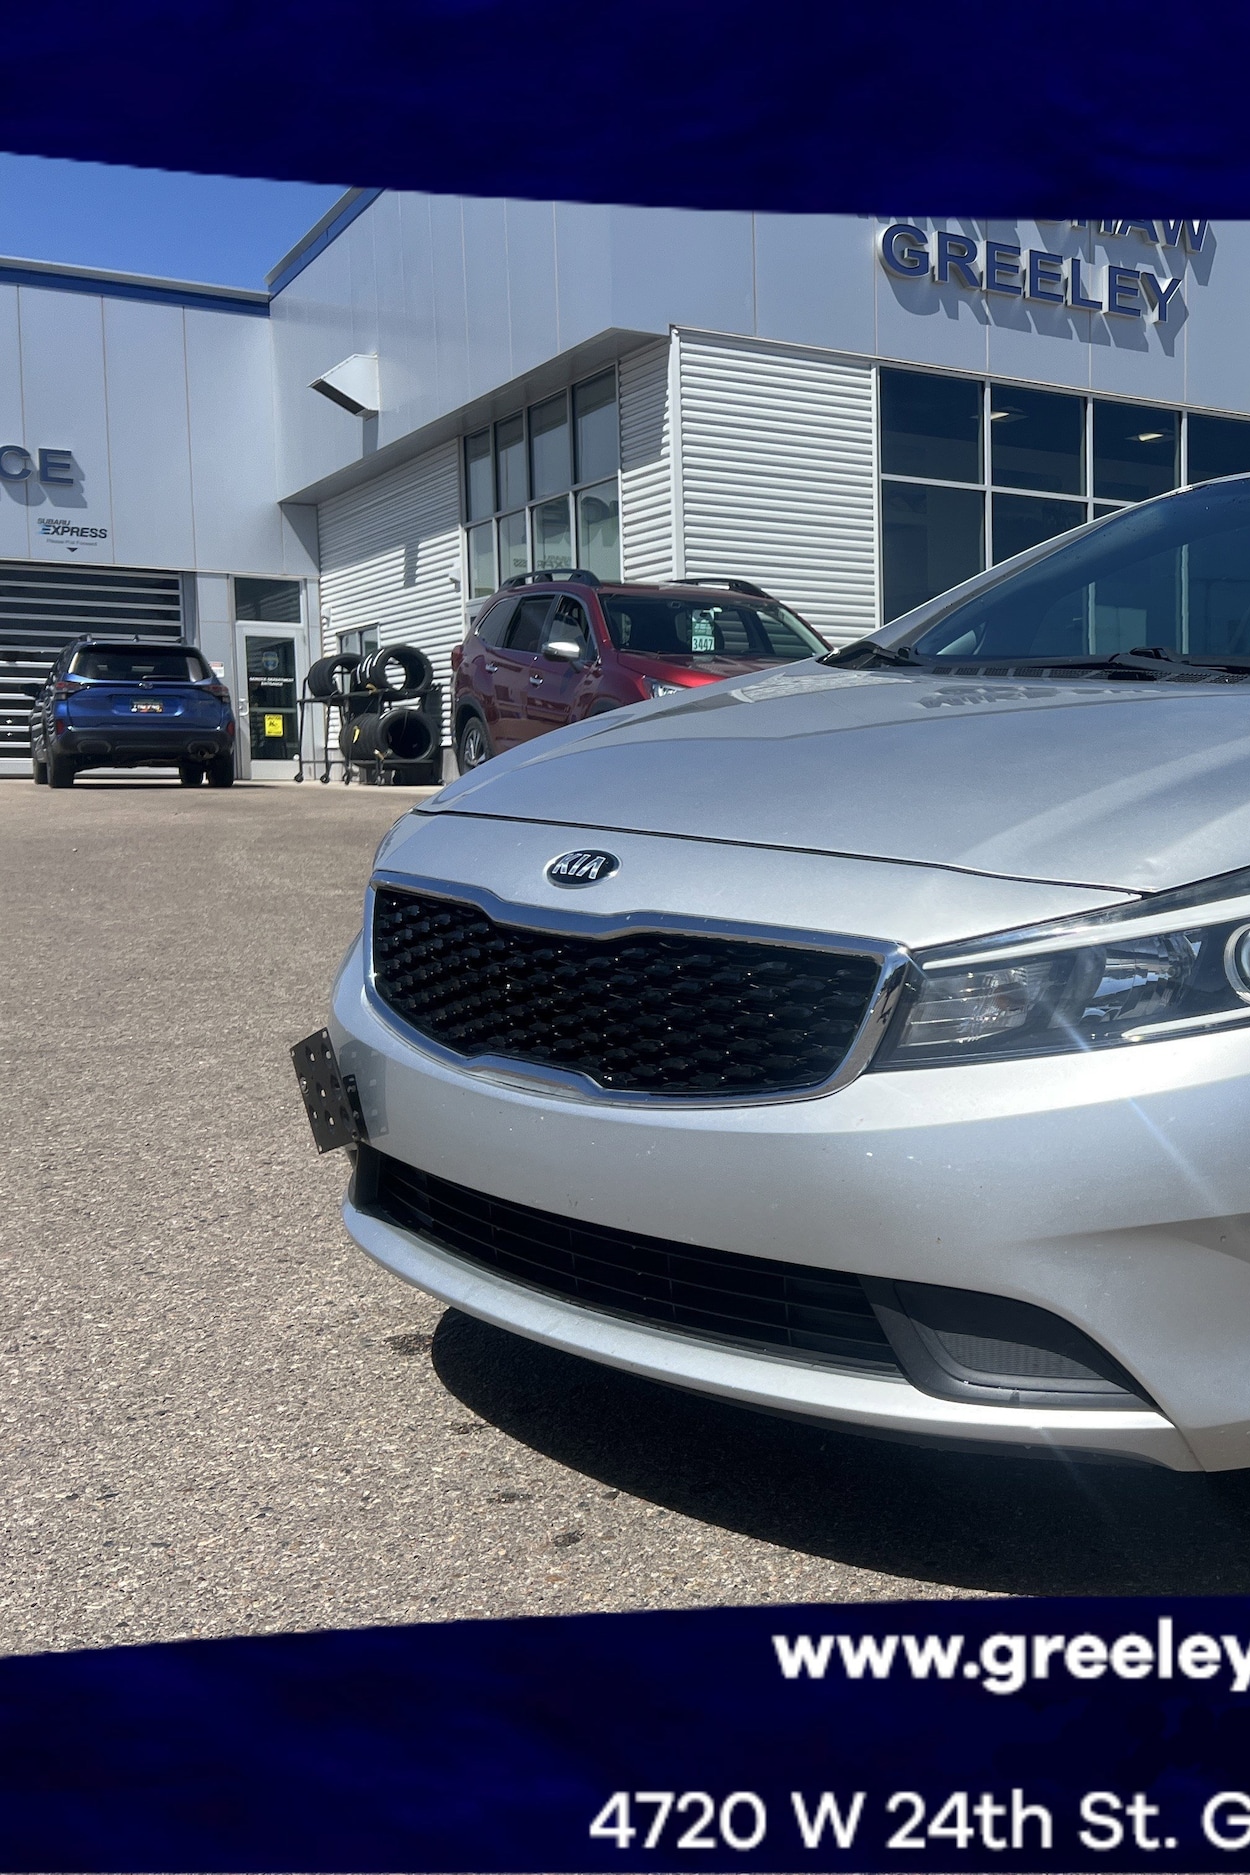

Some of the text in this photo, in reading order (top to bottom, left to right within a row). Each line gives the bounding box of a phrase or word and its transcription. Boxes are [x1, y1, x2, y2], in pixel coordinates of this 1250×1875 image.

[879, 223, 1181, 323] GREELEY
[37, 518, 71, 526] SUBARU
[39, 524, 108, 539] EXPRESS
[551, 853, 607, 880] KIA
